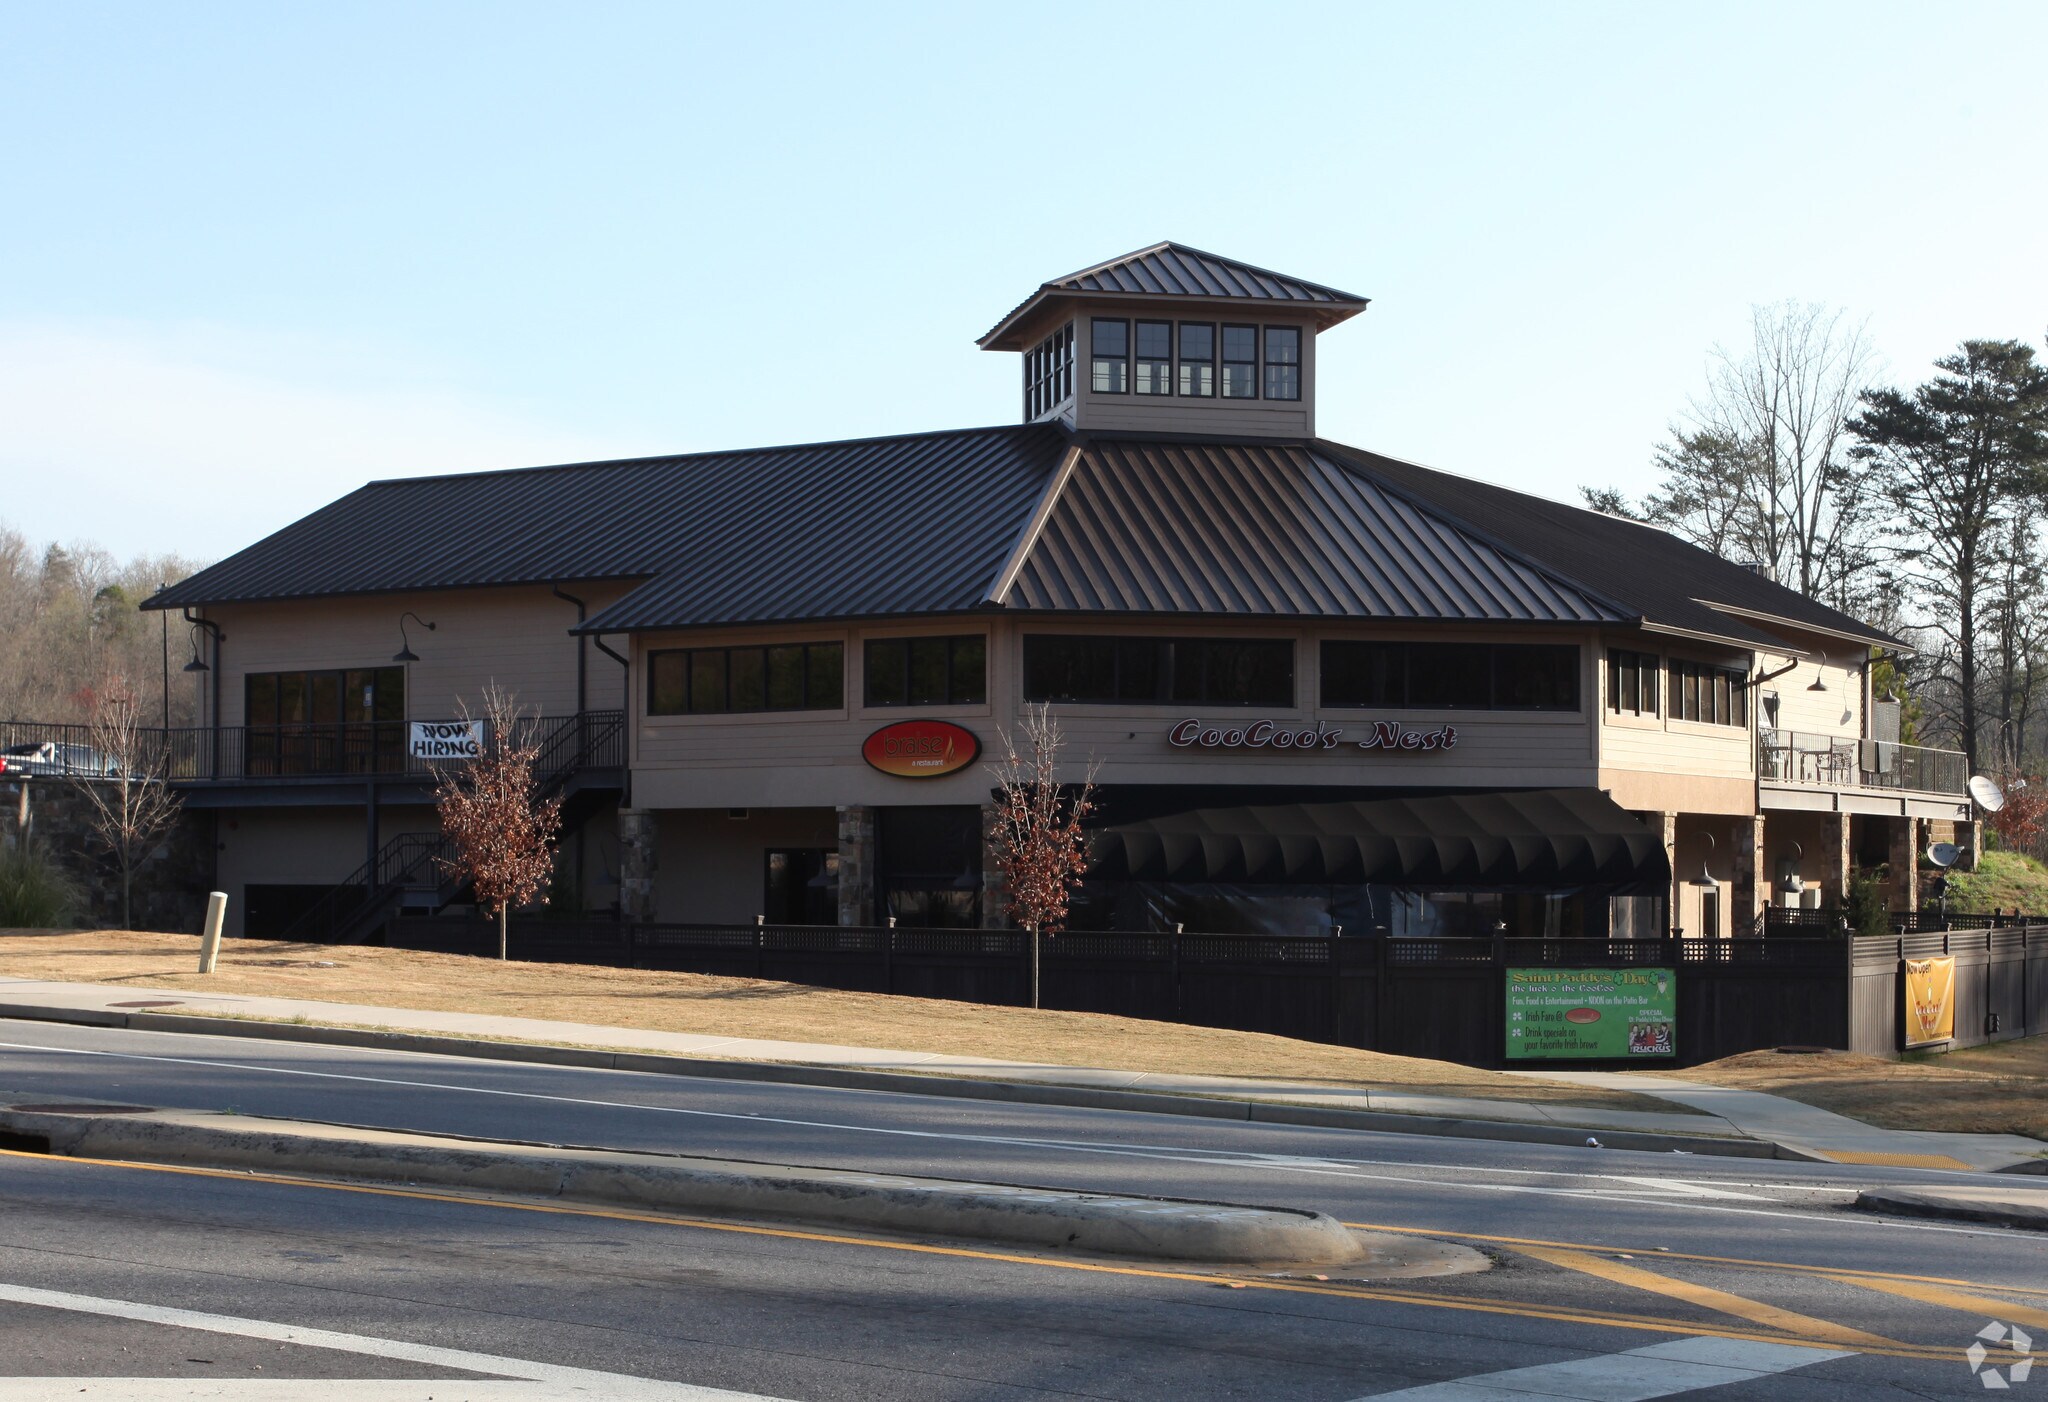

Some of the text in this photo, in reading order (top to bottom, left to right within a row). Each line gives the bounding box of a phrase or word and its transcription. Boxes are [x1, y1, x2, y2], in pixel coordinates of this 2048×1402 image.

[422, 724, 470, 739] NOW
[1169, 718, 1458, 750] CooCoo's Nest
[413, 740, 479, 756] HIRING
[883, 731, 944, 755] braise
[916, 759, 944, 767] restaurant
[1512, 972, 1649, 986] Saint Paddy's Day
[1511, 985, 1526, 993] the
[1529, 984, 1548, 993] luck
[1526, 996, 1540, 1006] Food
[1545, 996, 1583, 1006] Entertainment
[1589, 995, 1604, 1005] NOON
[1613, 996, 1623, 1005] the
[1623, 995, 1638, 1005] Patio
[1639, 995, 1648, 1005] Bar
[1526, 1010, 1540, 1022] Irish
[1542, 1010, 1554, 1022] Fare
[1525, 1026, 1577, 1040] Drink specials on
[1524, 1038, 1599, 1052] your favorite Irish brews
[1632, 1045, 1671, 1053] RUCKUS
